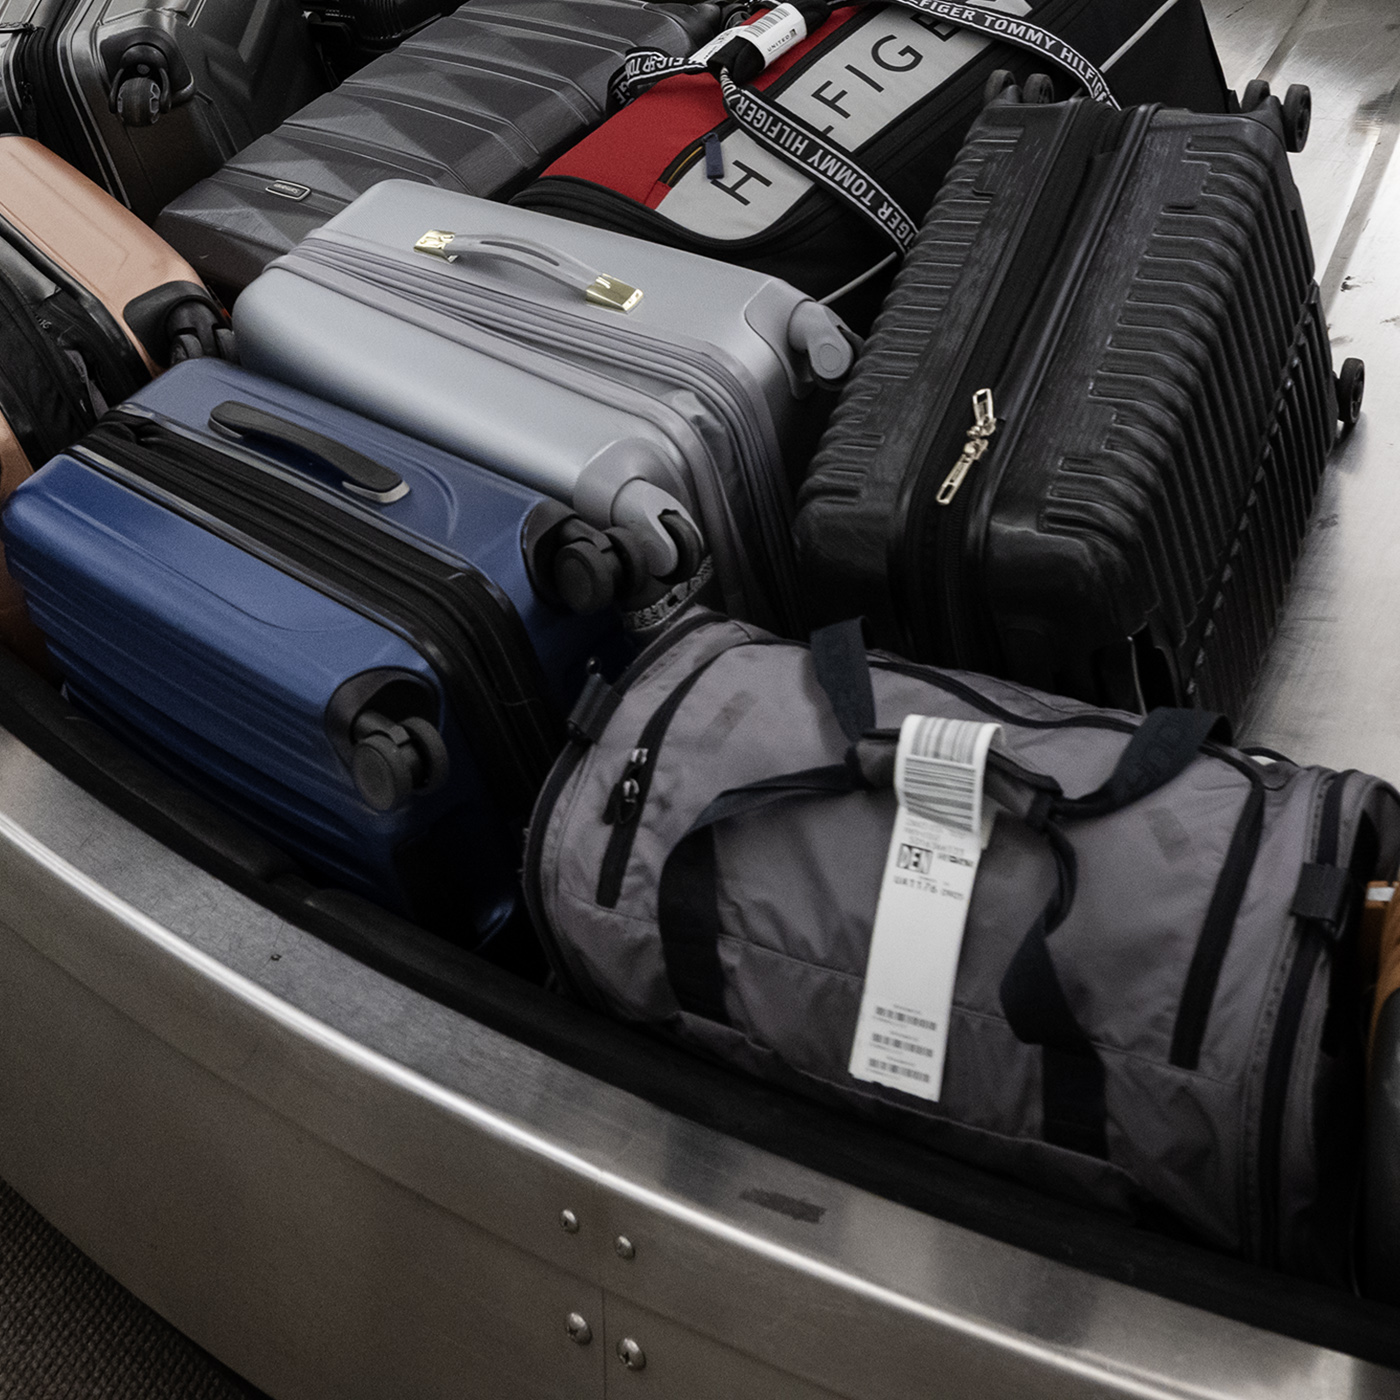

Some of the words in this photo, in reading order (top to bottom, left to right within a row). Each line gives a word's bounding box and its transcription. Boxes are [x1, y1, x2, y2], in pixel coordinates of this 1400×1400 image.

[984, 13, 1055, 50] TOMMY
[1060, 49, 1113, 105] HILFIGE
[735, 96, 809, 156] HILFIGER
[808, 149, 876, 206] TOMMY
[877, 201, 916, 249] IGER
